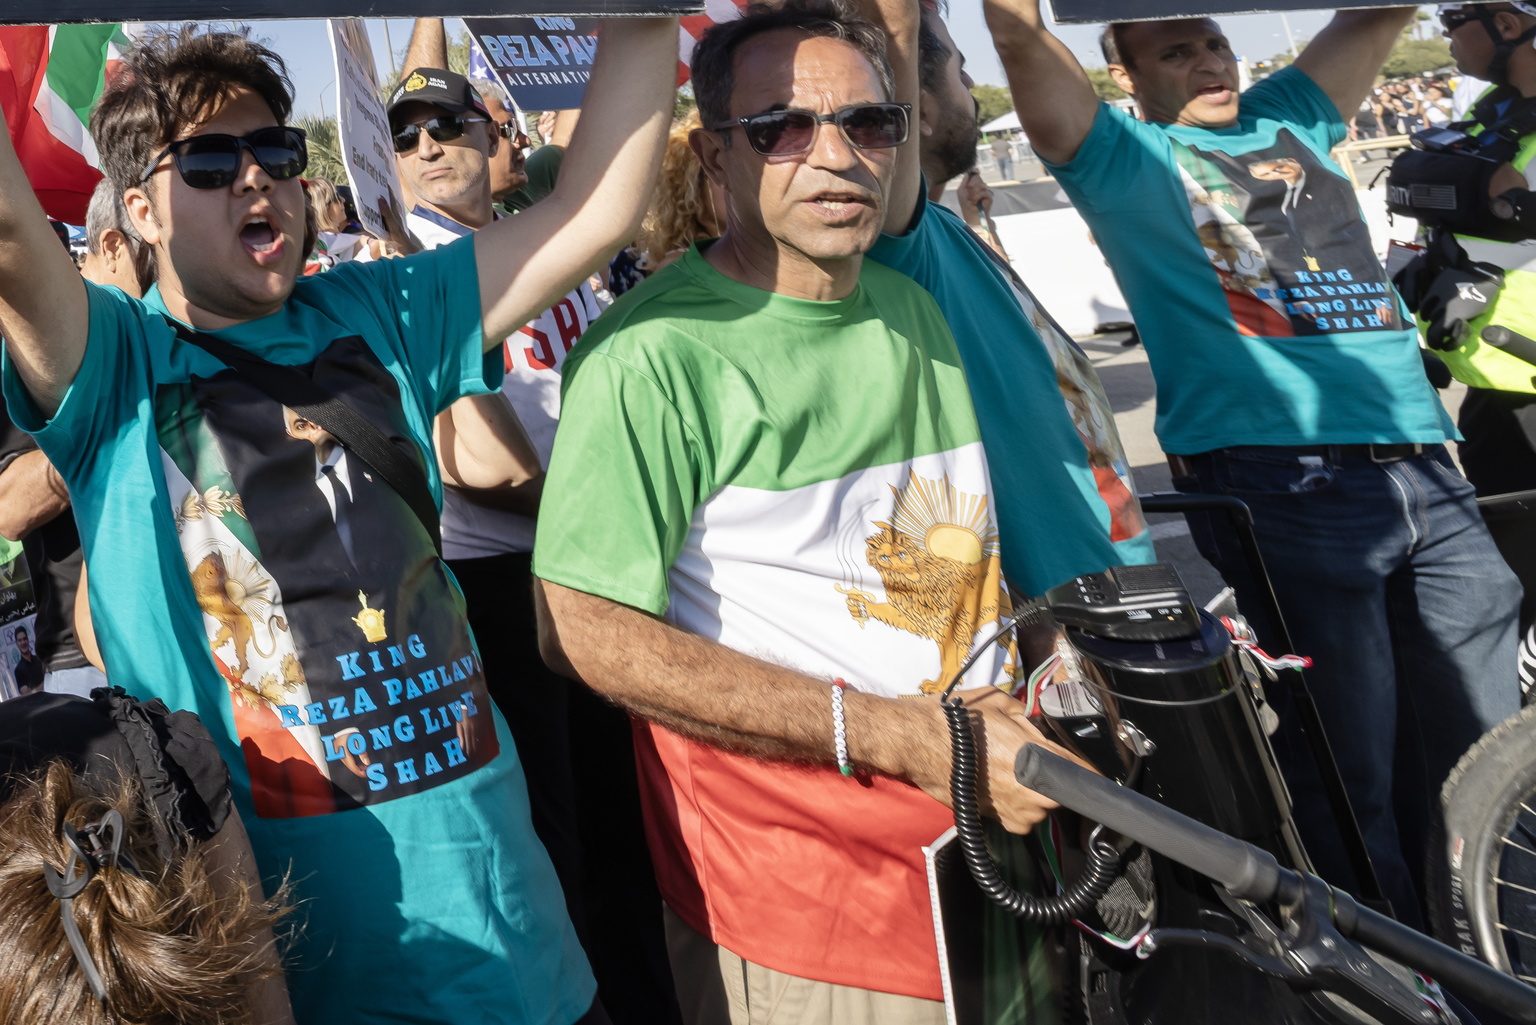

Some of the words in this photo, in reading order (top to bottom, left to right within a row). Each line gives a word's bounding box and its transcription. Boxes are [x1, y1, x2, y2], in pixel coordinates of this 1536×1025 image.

[532, 17, 576, 31] KING
[480, 35, 559, 67] REZA
[506, 71, 591, 86] ALTERNATIV
[1390, 184, 1410, 207] RITY
[1294, 268, 1354, 283] KING
[1254, 285, 1321, 300] REZA
[1285, 299, 1347, 315] LONG
[1349, 297, 1393, 311] LIVE
[1315, 314, 1385, 330] SHAH
[336, 633, 428, 682] KING
[278, 687, 376, 729] REZA
[321, 717, 417, 764] LONG
[420, 691, 479, 737] LIVE
[365, 736, 468, 792] SHAH
